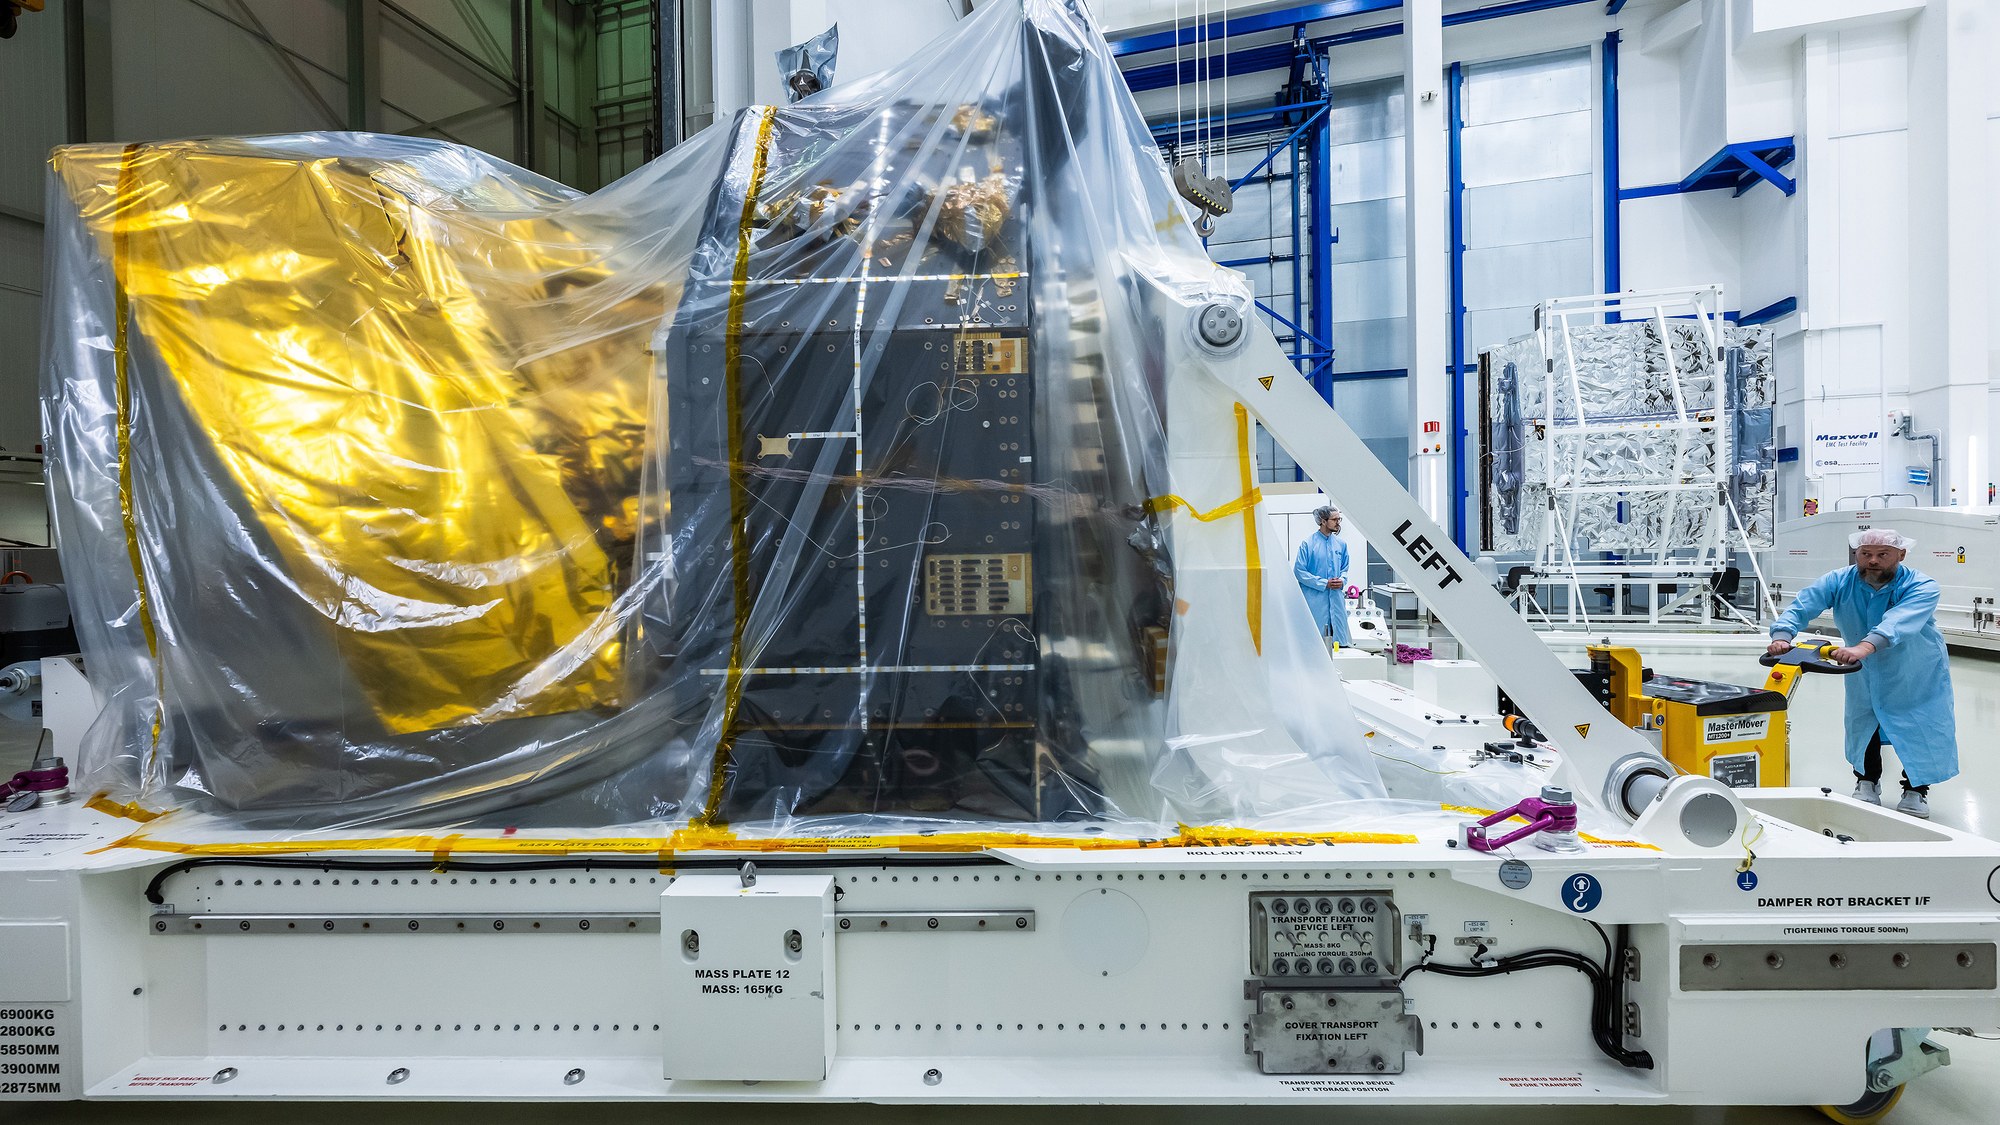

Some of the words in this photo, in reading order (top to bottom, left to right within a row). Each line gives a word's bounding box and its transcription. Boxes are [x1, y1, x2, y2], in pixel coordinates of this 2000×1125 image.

[1816, 432, 1878, 441] Maxwell
[1392, 519, 1463, 590] LEFT
[1708, 720, 1764, 732] MasterMover
[1264, 836, 1335, 847] ROT
[1758, 898, 1812, 907] DAMPER
[1816, 897, 1843, 906] ROT
[1848, 897, 1910, 906] BRACKET
[1915, 896, 1930, 906] I/F
[1783, 927, 1838, 935] (TIGHTENING
[695, 970, 728, 978] MASS
[733, 970, 772, 978] PLATE
[776, 970, 790, 978] 12
[702, 985, 740, 993] MASS:
[744, 985, 783, 993] 165KG
[0, 1009, 54, 1019] 6900KG
[0, 1026, 55, 1036] 2800KG
[0, 1045, 59, 1055] 5850MM
[1, 1064, 60, 1074] 3900MM
